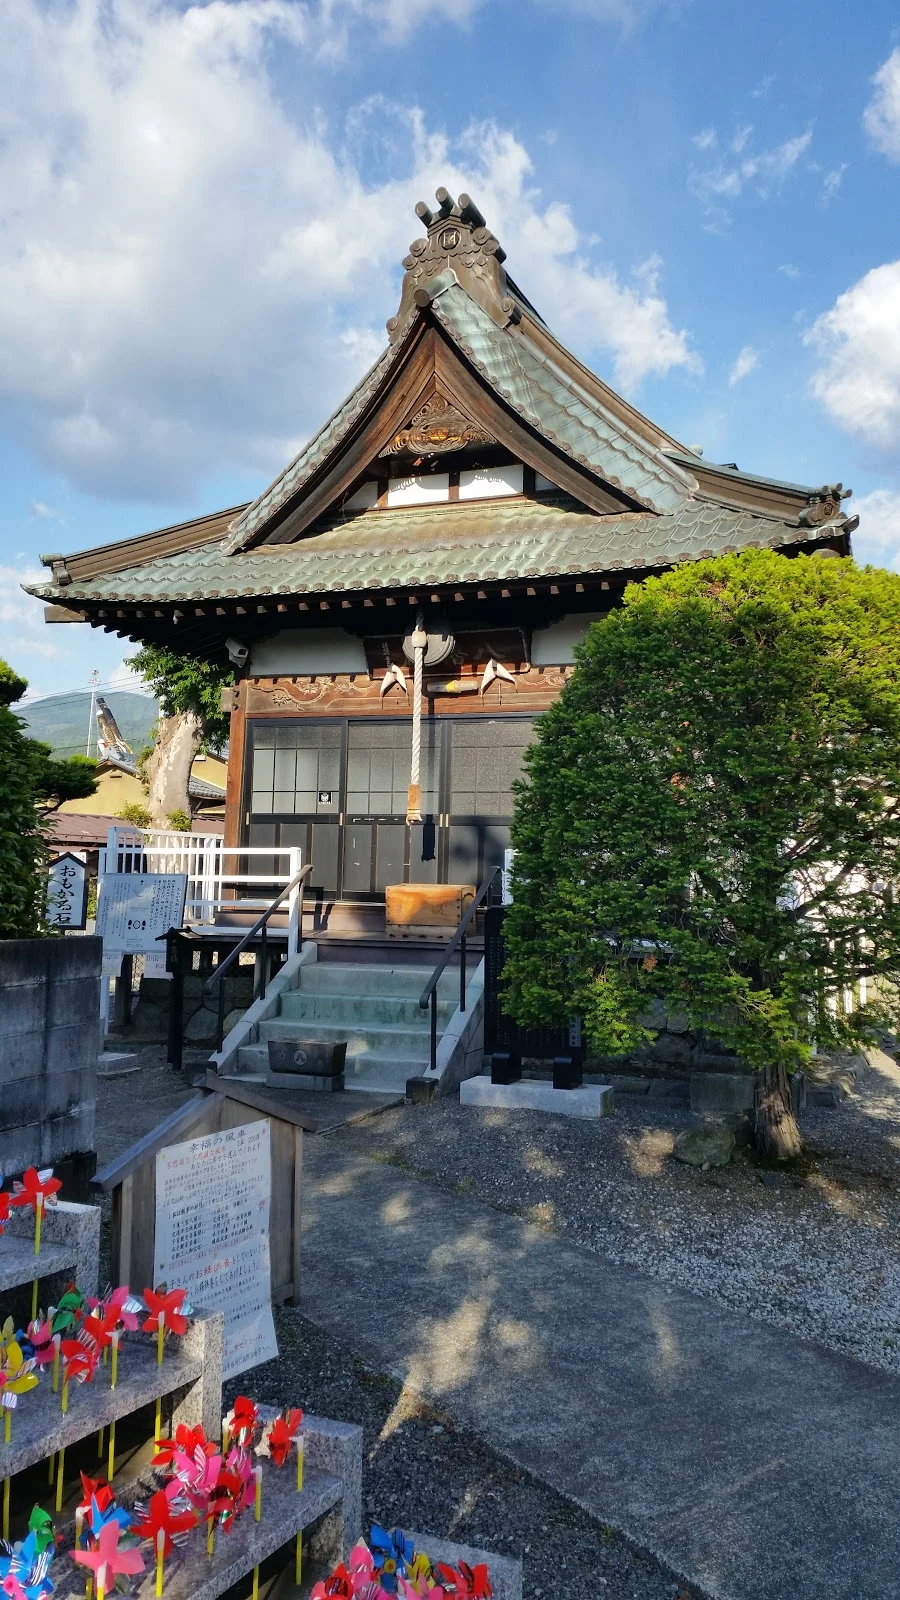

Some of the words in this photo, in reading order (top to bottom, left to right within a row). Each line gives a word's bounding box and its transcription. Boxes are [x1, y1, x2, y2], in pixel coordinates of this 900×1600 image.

[53, 865, 77, 922] おもかる石
[188, 1129, 246, 1153] 幸福の風車
